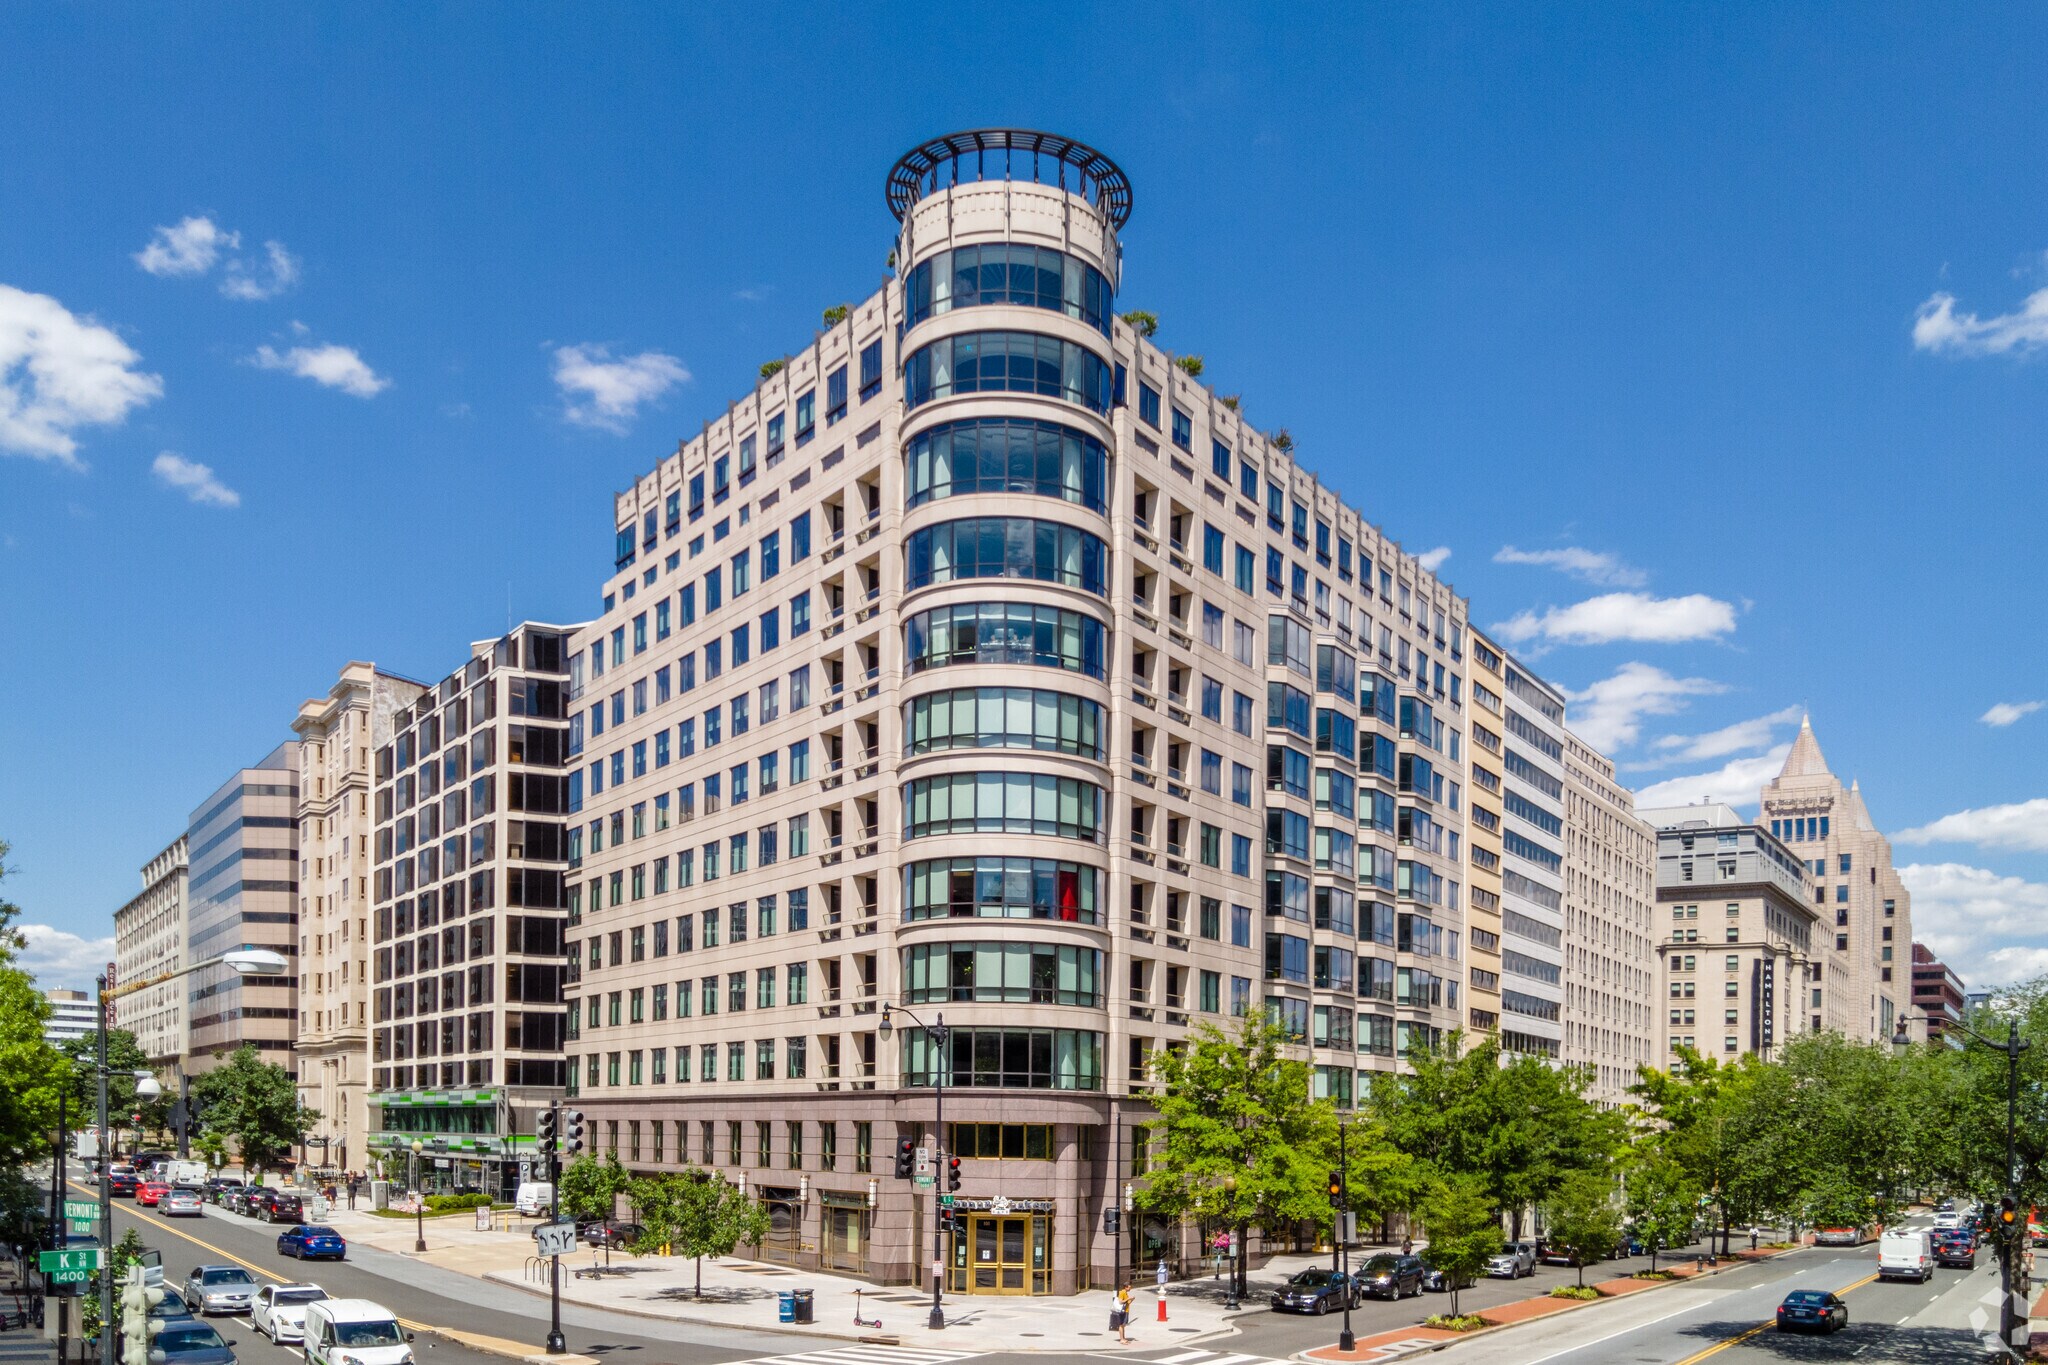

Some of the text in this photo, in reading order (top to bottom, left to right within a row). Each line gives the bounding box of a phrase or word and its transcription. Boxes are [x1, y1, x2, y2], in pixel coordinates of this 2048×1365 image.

[1764, 964, 1772, 1034] HAMILTON
[64, 1202, 94, 1218] VERMONT
[74, 1221, 90, 1232] 1000
[1148, 1239, 1161, 1249] OPEN
[60, 1252, 87, 1268] K St
[55, 1271, 85, 1282] 1400
